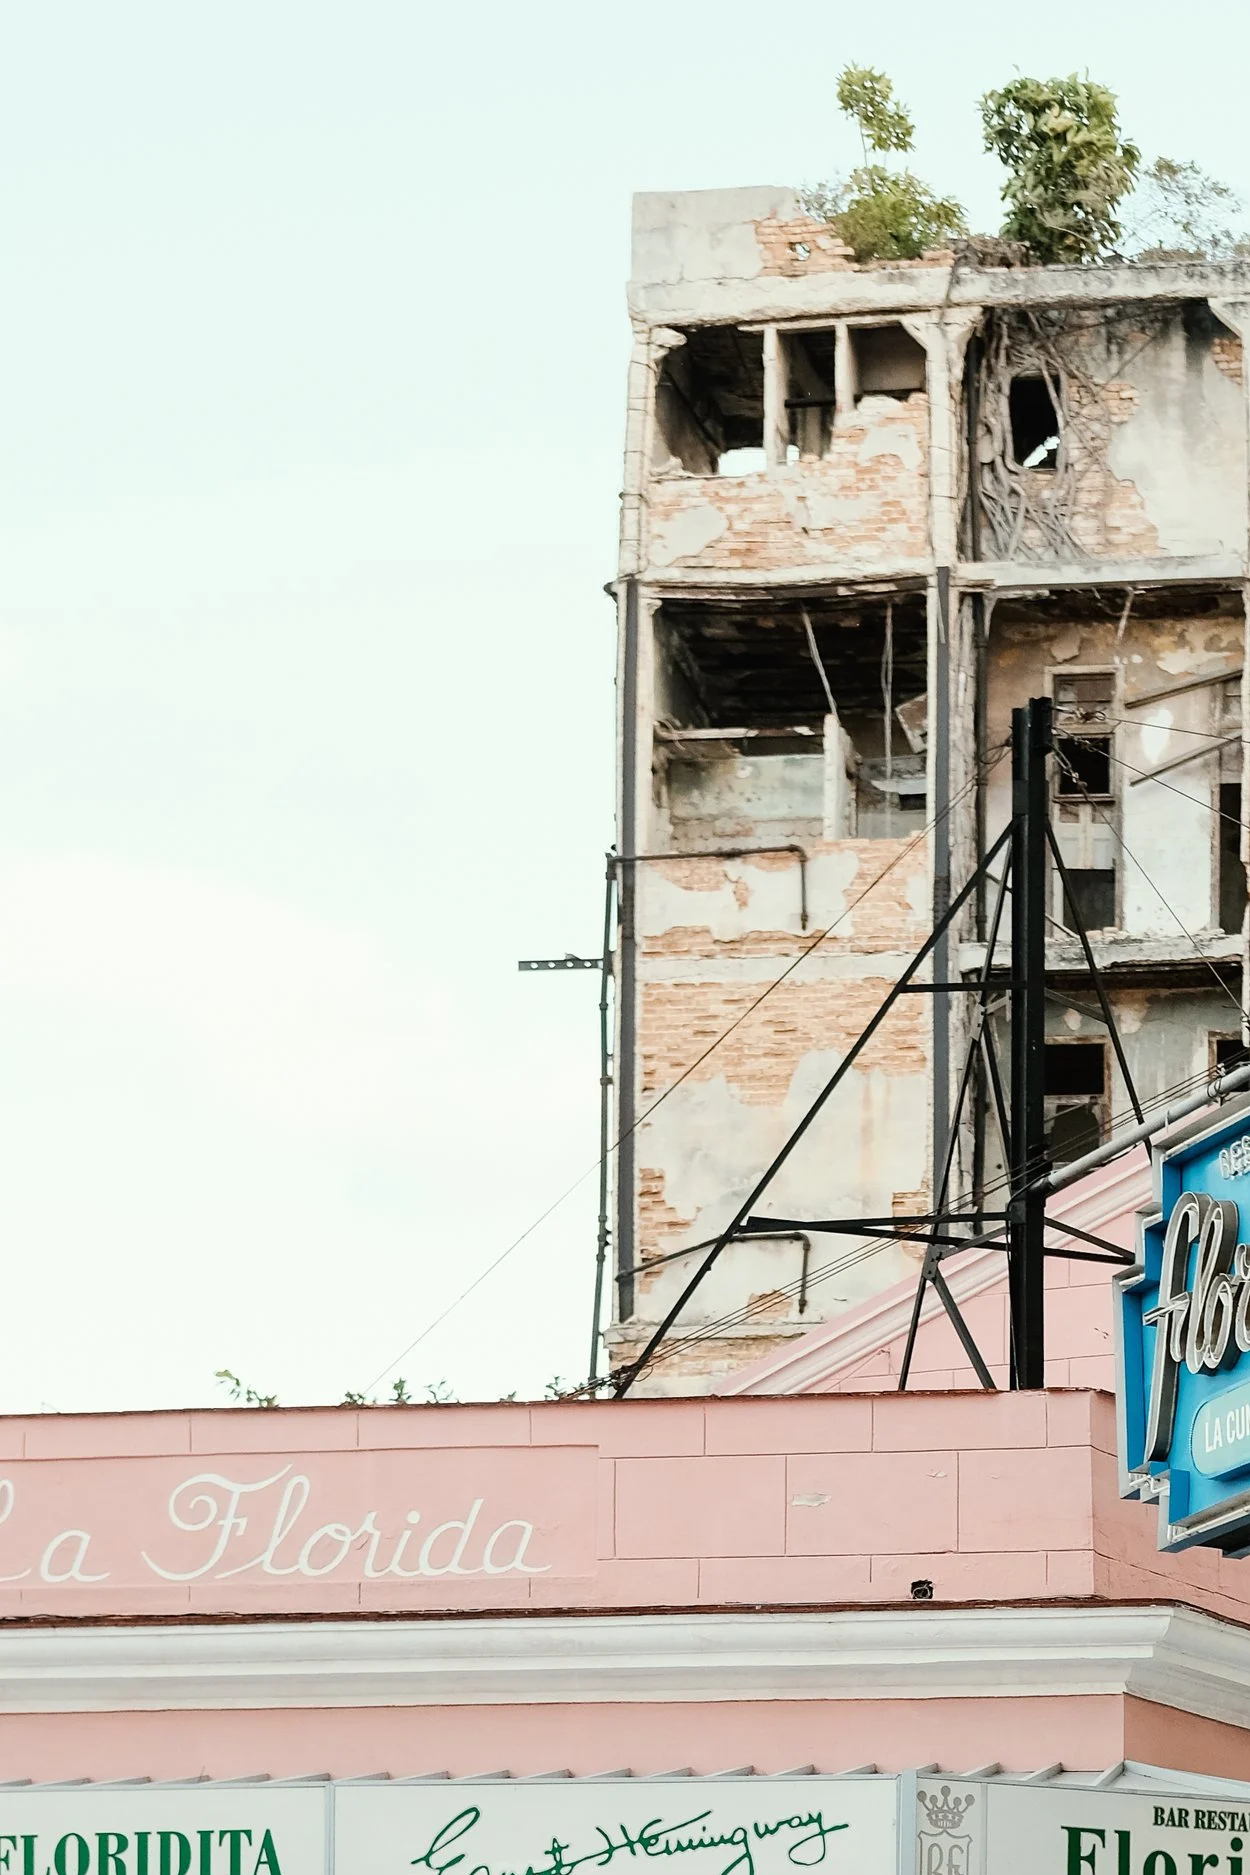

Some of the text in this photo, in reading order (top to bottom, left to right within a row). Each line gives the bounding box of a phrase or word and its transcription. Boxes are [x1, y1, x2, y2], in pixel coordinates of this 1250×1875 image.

[1205, 1417, 1222, 1453] LA
[141, 1464, 552, 1581] Florida
[1152, 1806, 1190, 1829] BAR
